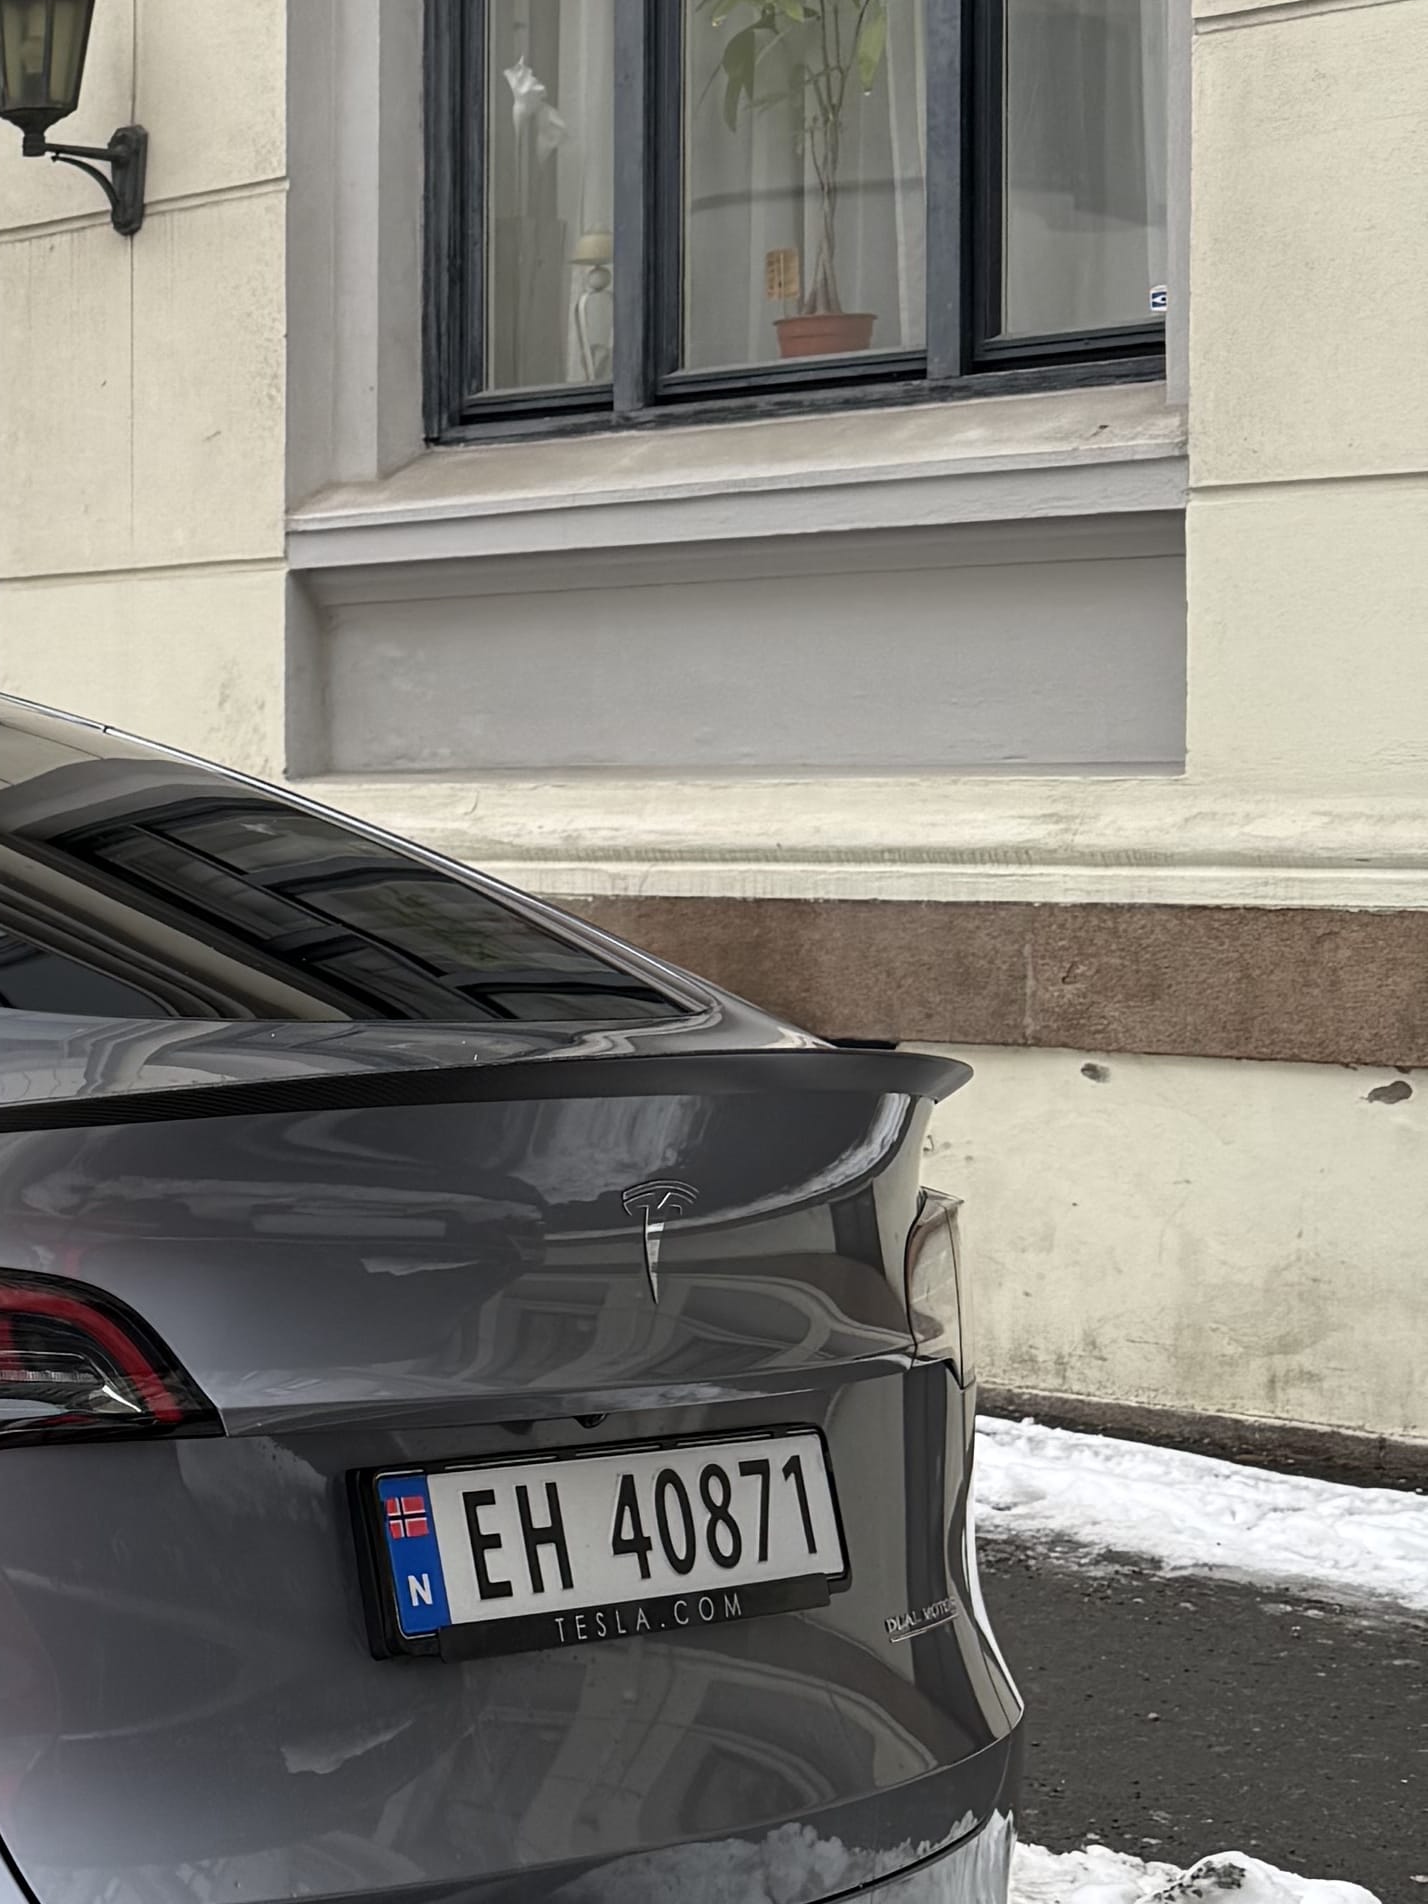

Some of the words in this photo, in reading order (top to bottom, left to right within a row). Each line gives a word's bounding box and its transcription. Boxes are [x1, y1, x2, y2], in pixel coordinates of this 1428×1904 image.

[461, 1481, 575, 1601] EH
[612, 1454, 818, 1581] 40871
[407, 1573, 433, 1608] N
[553, 1592, 743, 1644] TESLA.COM
